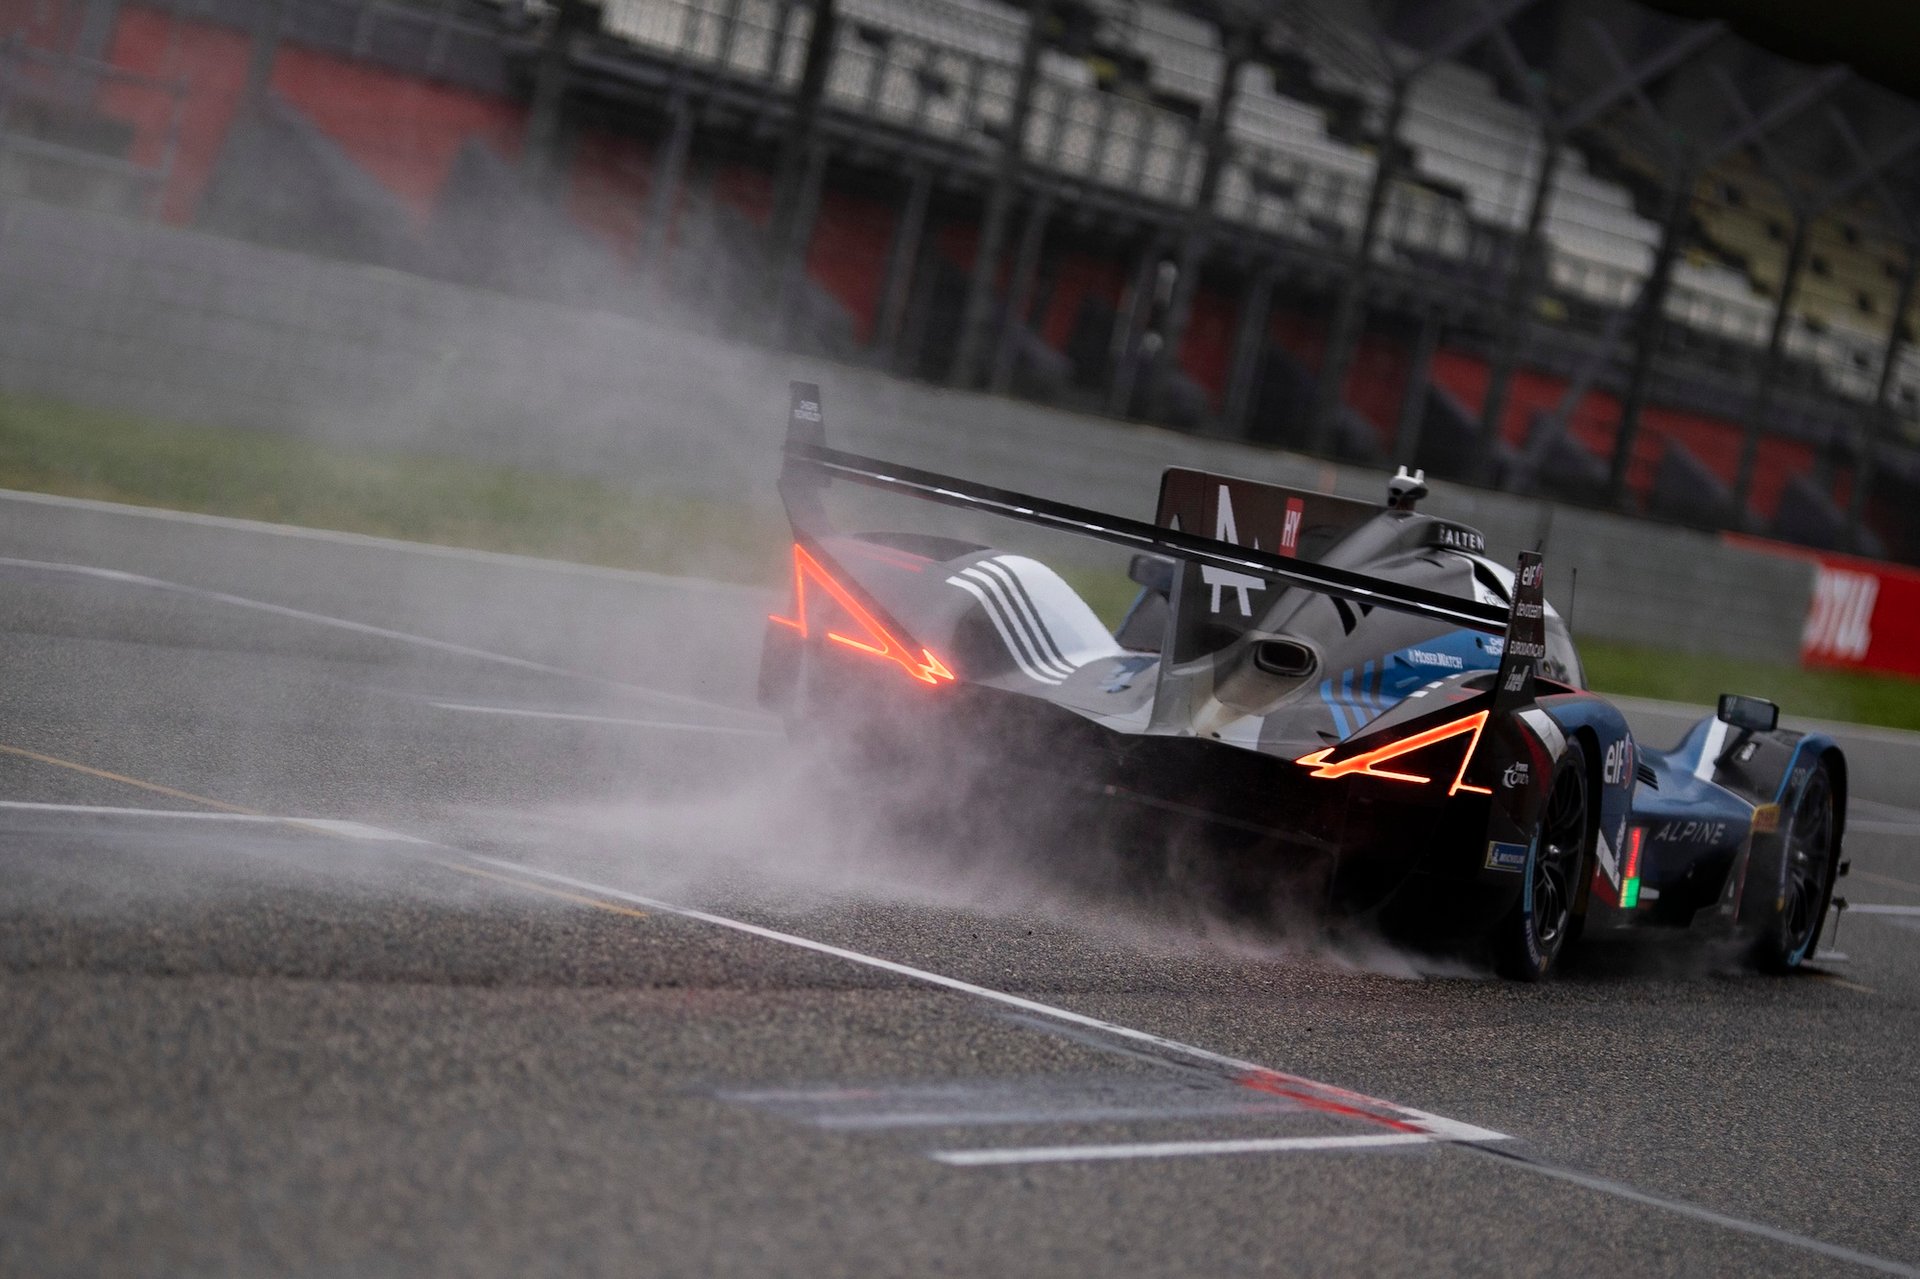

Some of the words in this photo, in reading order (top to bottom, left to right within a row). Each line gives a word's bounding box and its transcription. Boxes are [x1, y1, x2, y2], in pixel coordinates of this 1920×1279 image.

[1446, 529, 1485, 551] ALTEN
[1522, 566, 1536, 586] elf
[1604, 740, 1624, 783] elf
[1655, 822, 1726, 844] ALPINE
